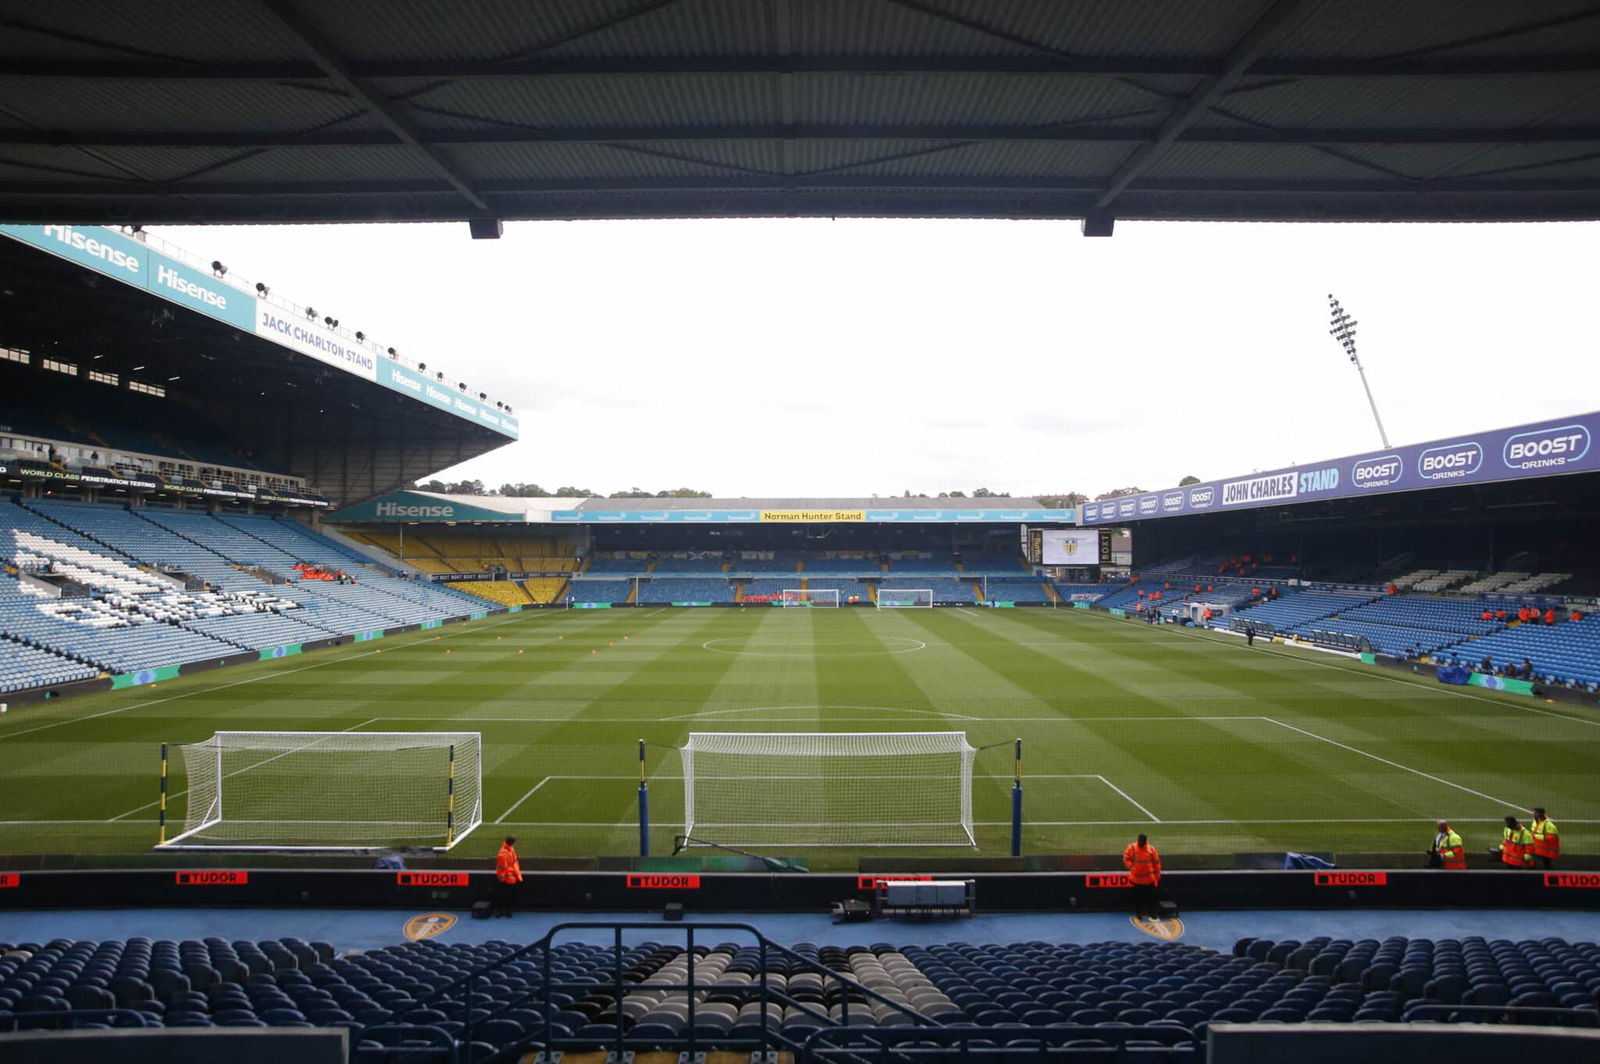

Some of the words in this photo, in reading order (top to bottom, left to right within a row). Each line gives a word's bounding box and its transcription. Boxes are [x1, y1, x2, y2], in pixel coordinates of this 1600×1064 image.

[157, 264, 227, 310] Hisense
[262, 313, 292, 337] JACK
[294, 326, 345, 358] CHARLTON
[346, 350, 373, 370] STAND
[1510, 434, 1583, 459] BOOST
[1423, 450, 1477, 471] BOOST
[1521, 457, 1566, 469] DRINKS
[1356, 462, 1398, 480] BOOST
[1432, 470, 1466, 480] DRINKS
[20, 468, 53, 477] WORLD
[54, 472, 80, 480] CLASS
[81, 475, 129, 485] PENETRATION
[130, 480, 156, 488] TESTING
[1363, 480, 1390, 488] DRINKS
[1225, 484, 1249, 502] JOHN
[1250, 475, 1294, 499] CHARLES
[1299, 468, 1340, 493] STAND
[1191, 491, 1212, 503] BOOST
[376, 502, 454, 516] Hisense
[764, 512, 800, 520] Norman
[801, 512, 833, 520] Hunter
[835, 512, 862, 520] Stand
[192, 872, 237, 882] TUDOR
[413, 874, 458, 884] TUDOR
[642, 876, 689, 886] TUDOR
[1101, 876, 1134, 885] TUD
[1330, 874, 1376, 883] TUDOR
[1561, 875, 1600, 885] TUDO
